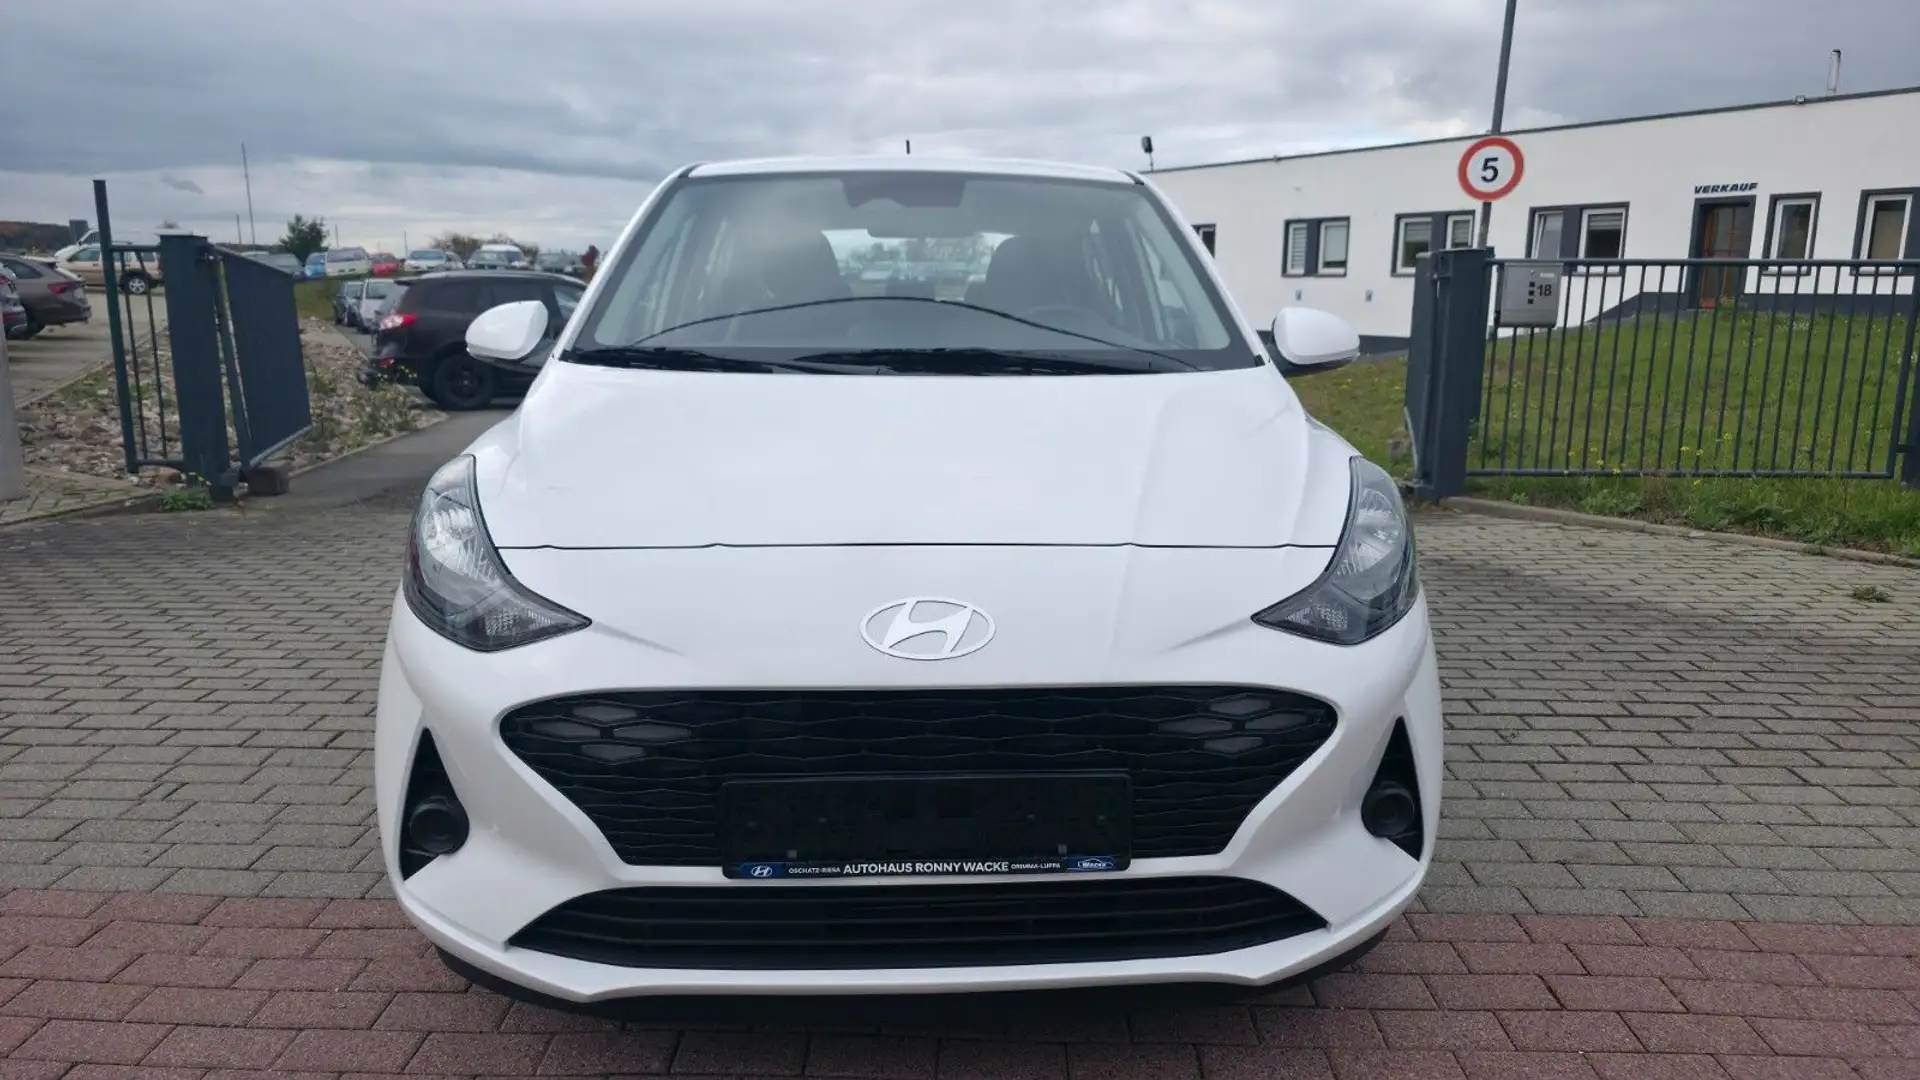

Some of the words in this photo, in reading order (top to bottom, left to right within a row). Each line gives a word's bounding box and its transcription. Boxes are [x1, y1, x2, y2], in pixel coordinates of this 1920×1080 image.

[1481, 157, 1499, 183] 5
[1694, 182, 1758, 195] VERKAUF
[1537, 284, 1552, 297] 18
[843, 862, 913, 874] AUTOHAUS
[915, 861, 962, 873] RONNY
[963, 861, 1009, 873] WACKE
